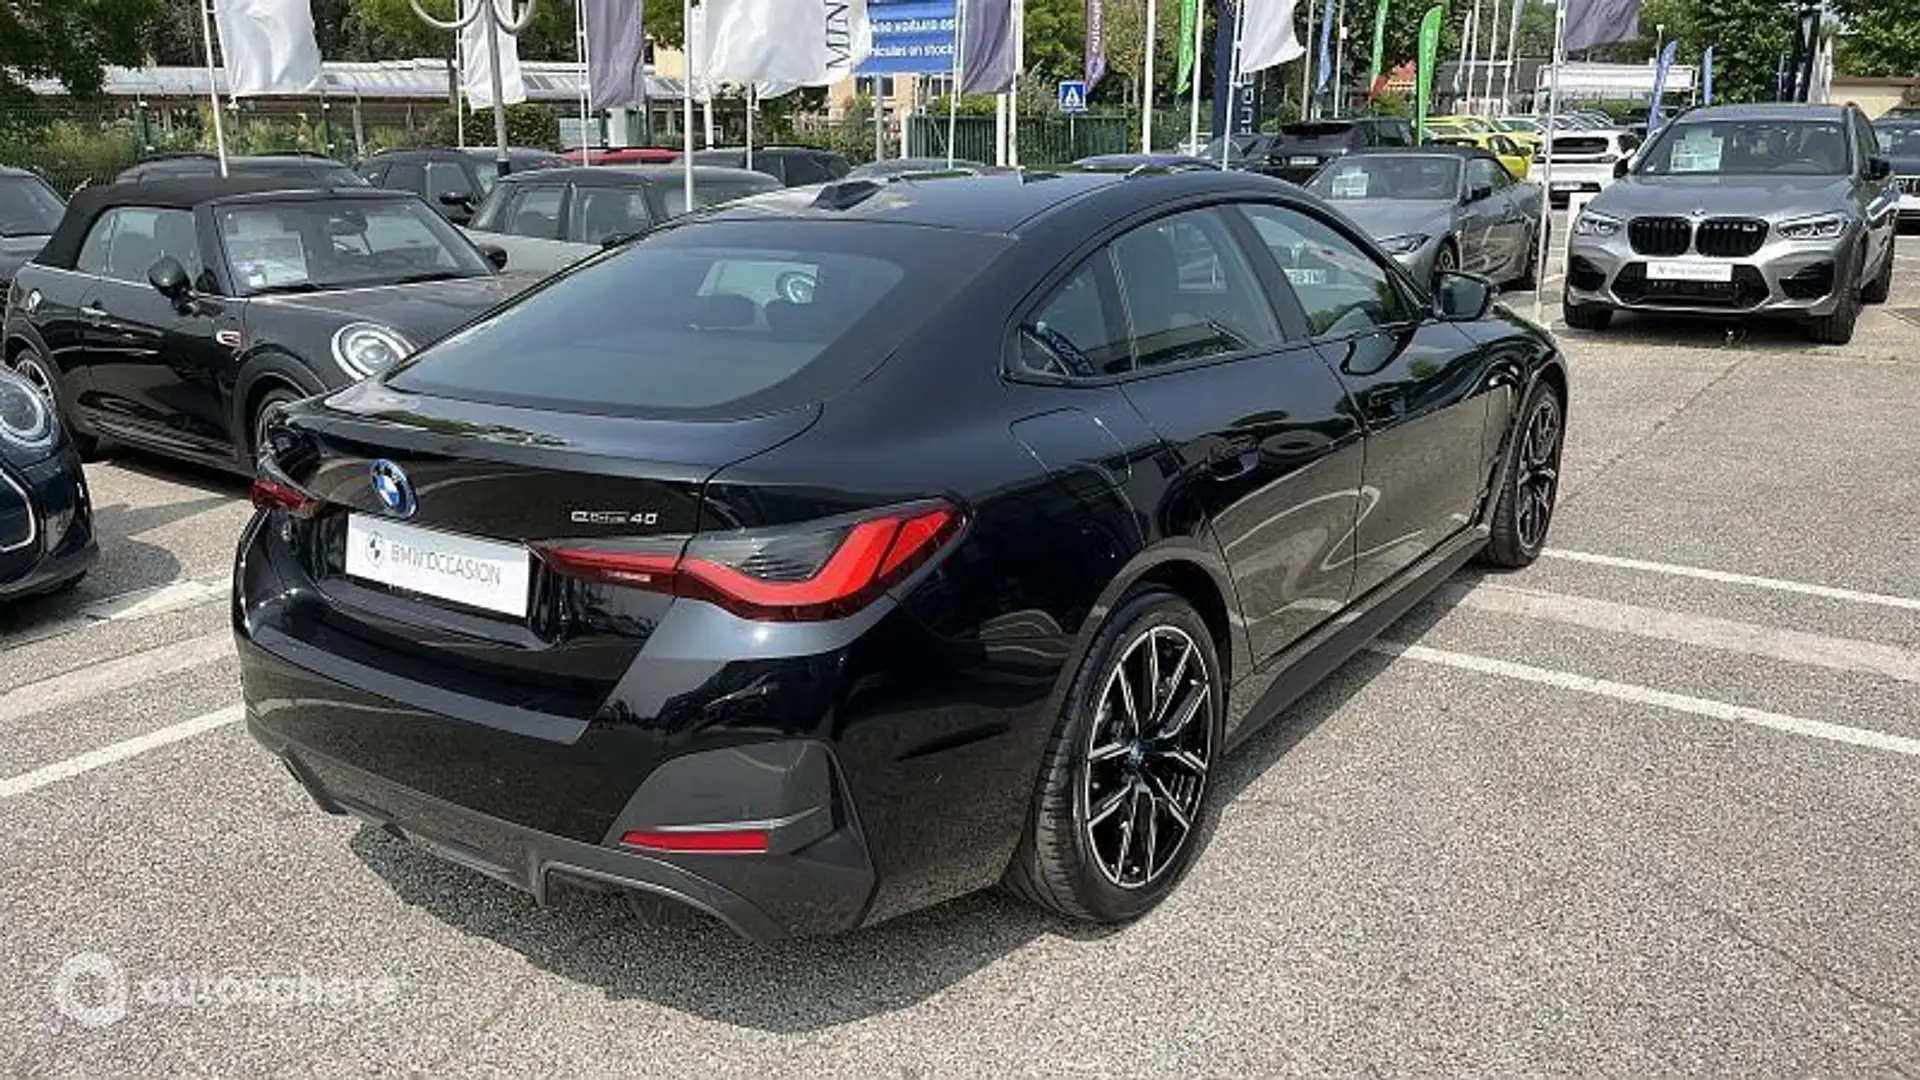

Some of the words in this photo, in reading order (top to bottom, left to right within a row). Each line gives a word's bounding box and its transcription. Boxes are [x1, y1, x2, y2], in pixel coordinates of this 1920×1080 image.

[630, 513, 658, 525] 40
[390, 543, 424, 565] BMW
[425, 551, 502, 586] OCCASION
